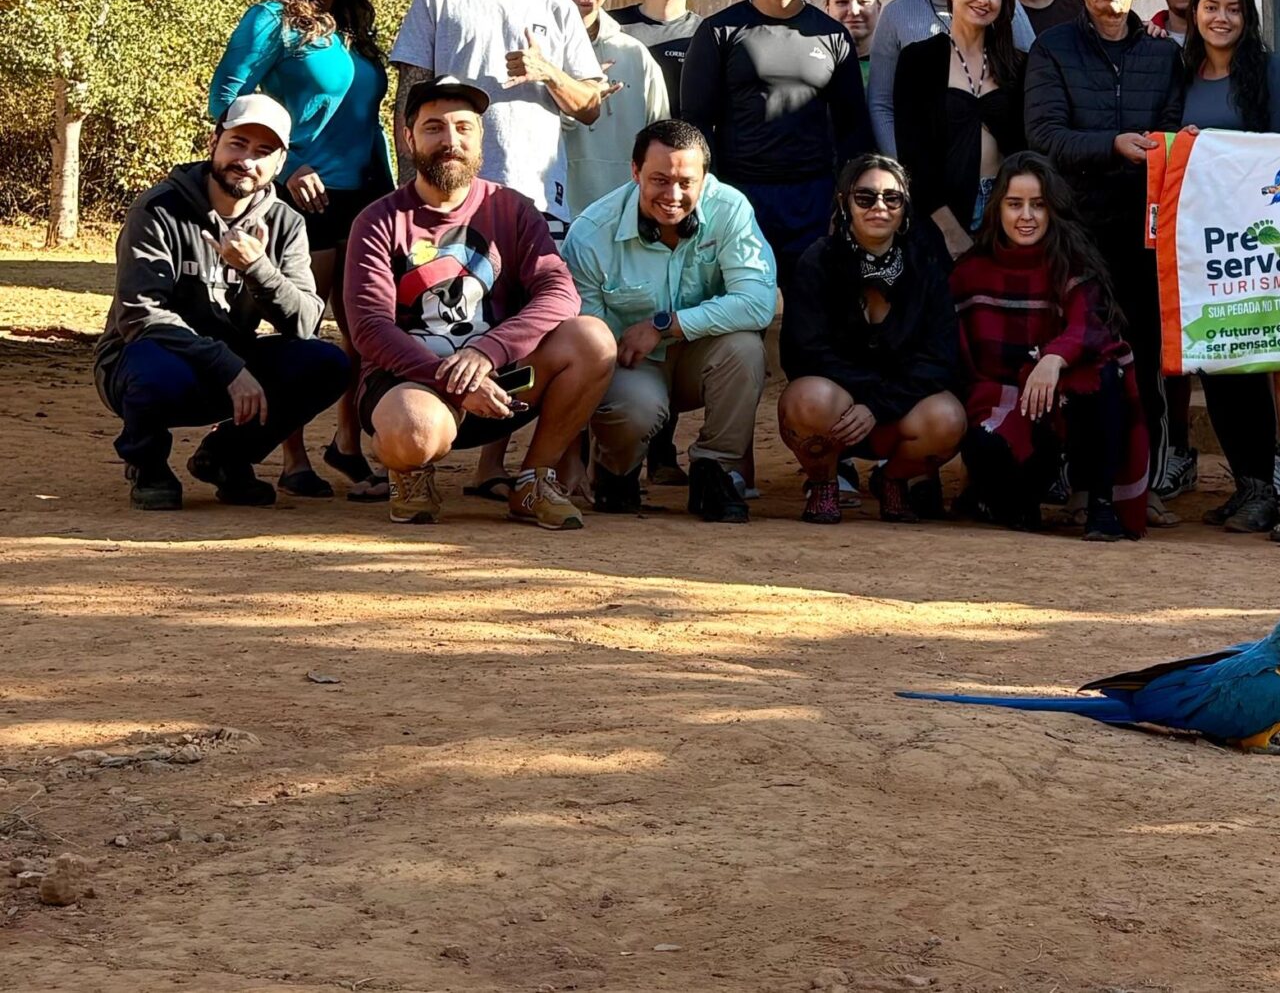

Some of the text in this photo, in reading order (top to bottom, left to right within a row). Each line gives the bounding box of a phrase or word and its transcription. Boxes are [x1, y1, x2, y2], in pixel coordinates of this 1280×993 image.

[1204, 226, 1259, 254] Pre
[1208, 305, 1226, 319] SUA
[1227, 303, 1261, 316] PEGADA
[1261, 301, 1273, 313] NO
[1206, 329, 1217, 340] O
[1219, 325, 1260, 338] futuro
[1206, 342, 1227, 353] ser
